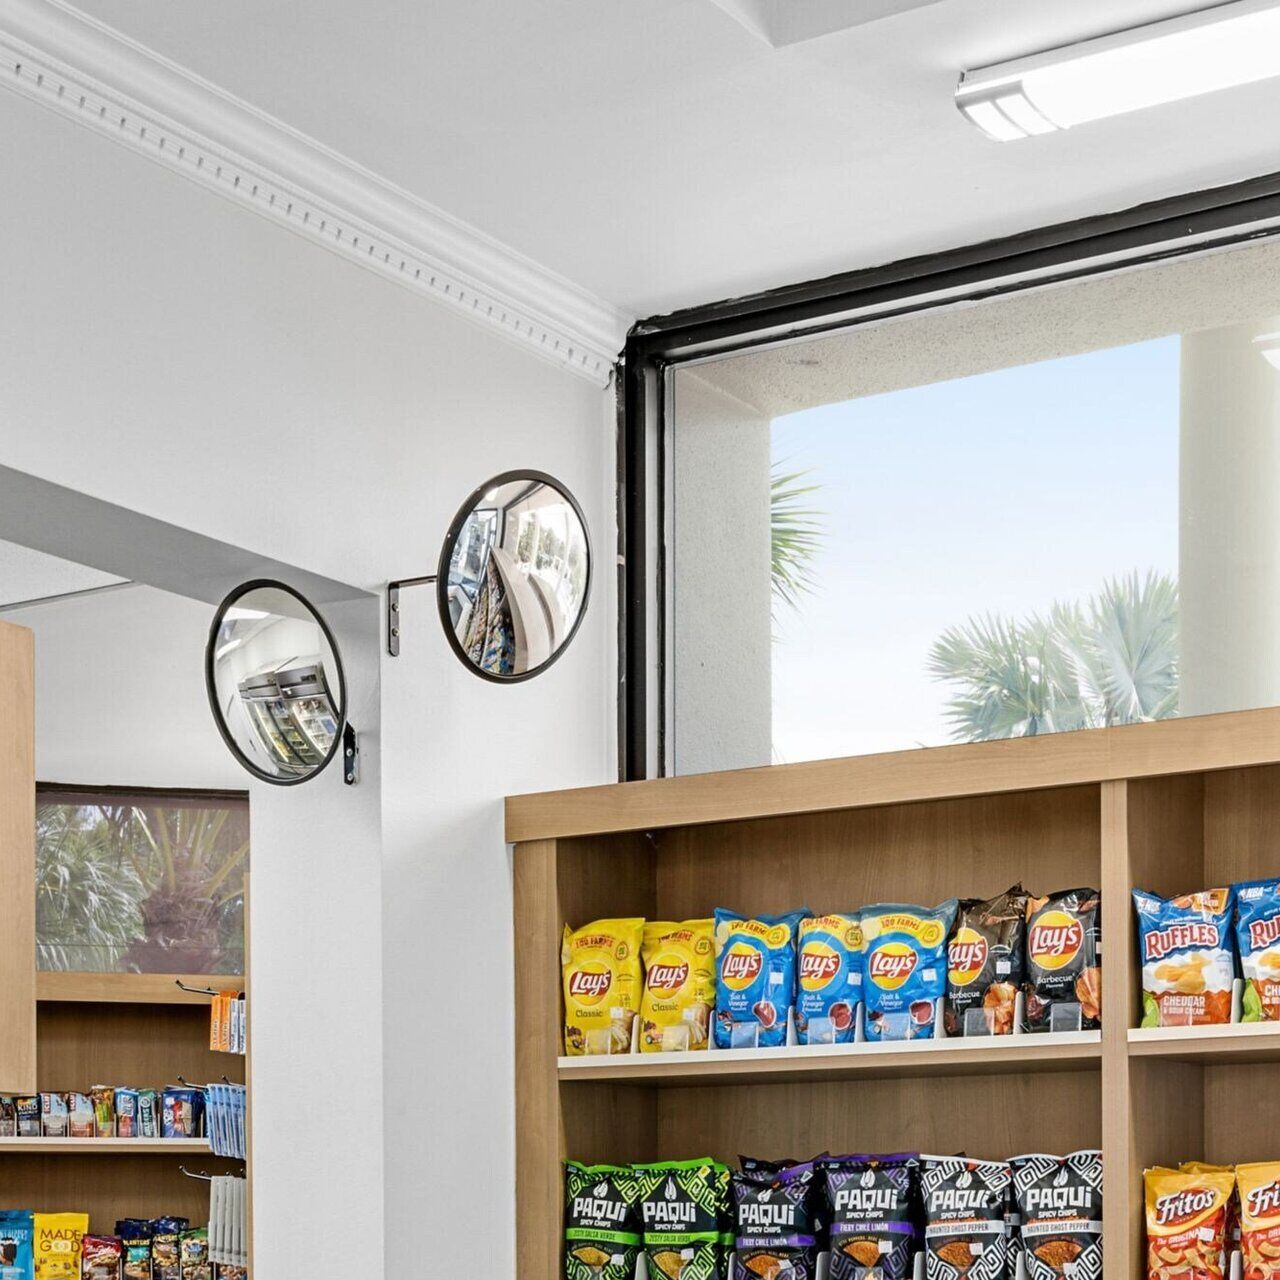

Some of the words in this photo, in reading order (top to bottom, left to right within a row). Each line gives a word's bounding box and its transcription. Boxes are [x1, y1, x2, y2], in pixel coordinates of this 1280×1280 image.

[1033, 925, 1079, 956] Lay's
[1146, 923, 1218, 958] RUFFLES
[723, 952, 760, 977] Lay's
[800, 952, 839, 977] Lay's
[872, 955, 916, 976] Lay's
[572, 970, 610, 993] Lay's
[649, 963, 686, 988] Lay's
[1037, 975, 1073, 984] Barbecue
[652, 1002, 679, 1012] Classic
[1163, 996, 1206, 1008] CHEDDAR
[576, 1008, 604, 1018] Classic
[846, 1211, 864, 1219] SPICY
[865, 1210, 884, 1219] CHIPS
[1157, 1188, 1216, 1226] Fritos
[40, 1229, 81, 1240] MADE
[968, 1222, 989, 1232] PEPPER
[40, 1241, 80, 1252] GOOD
